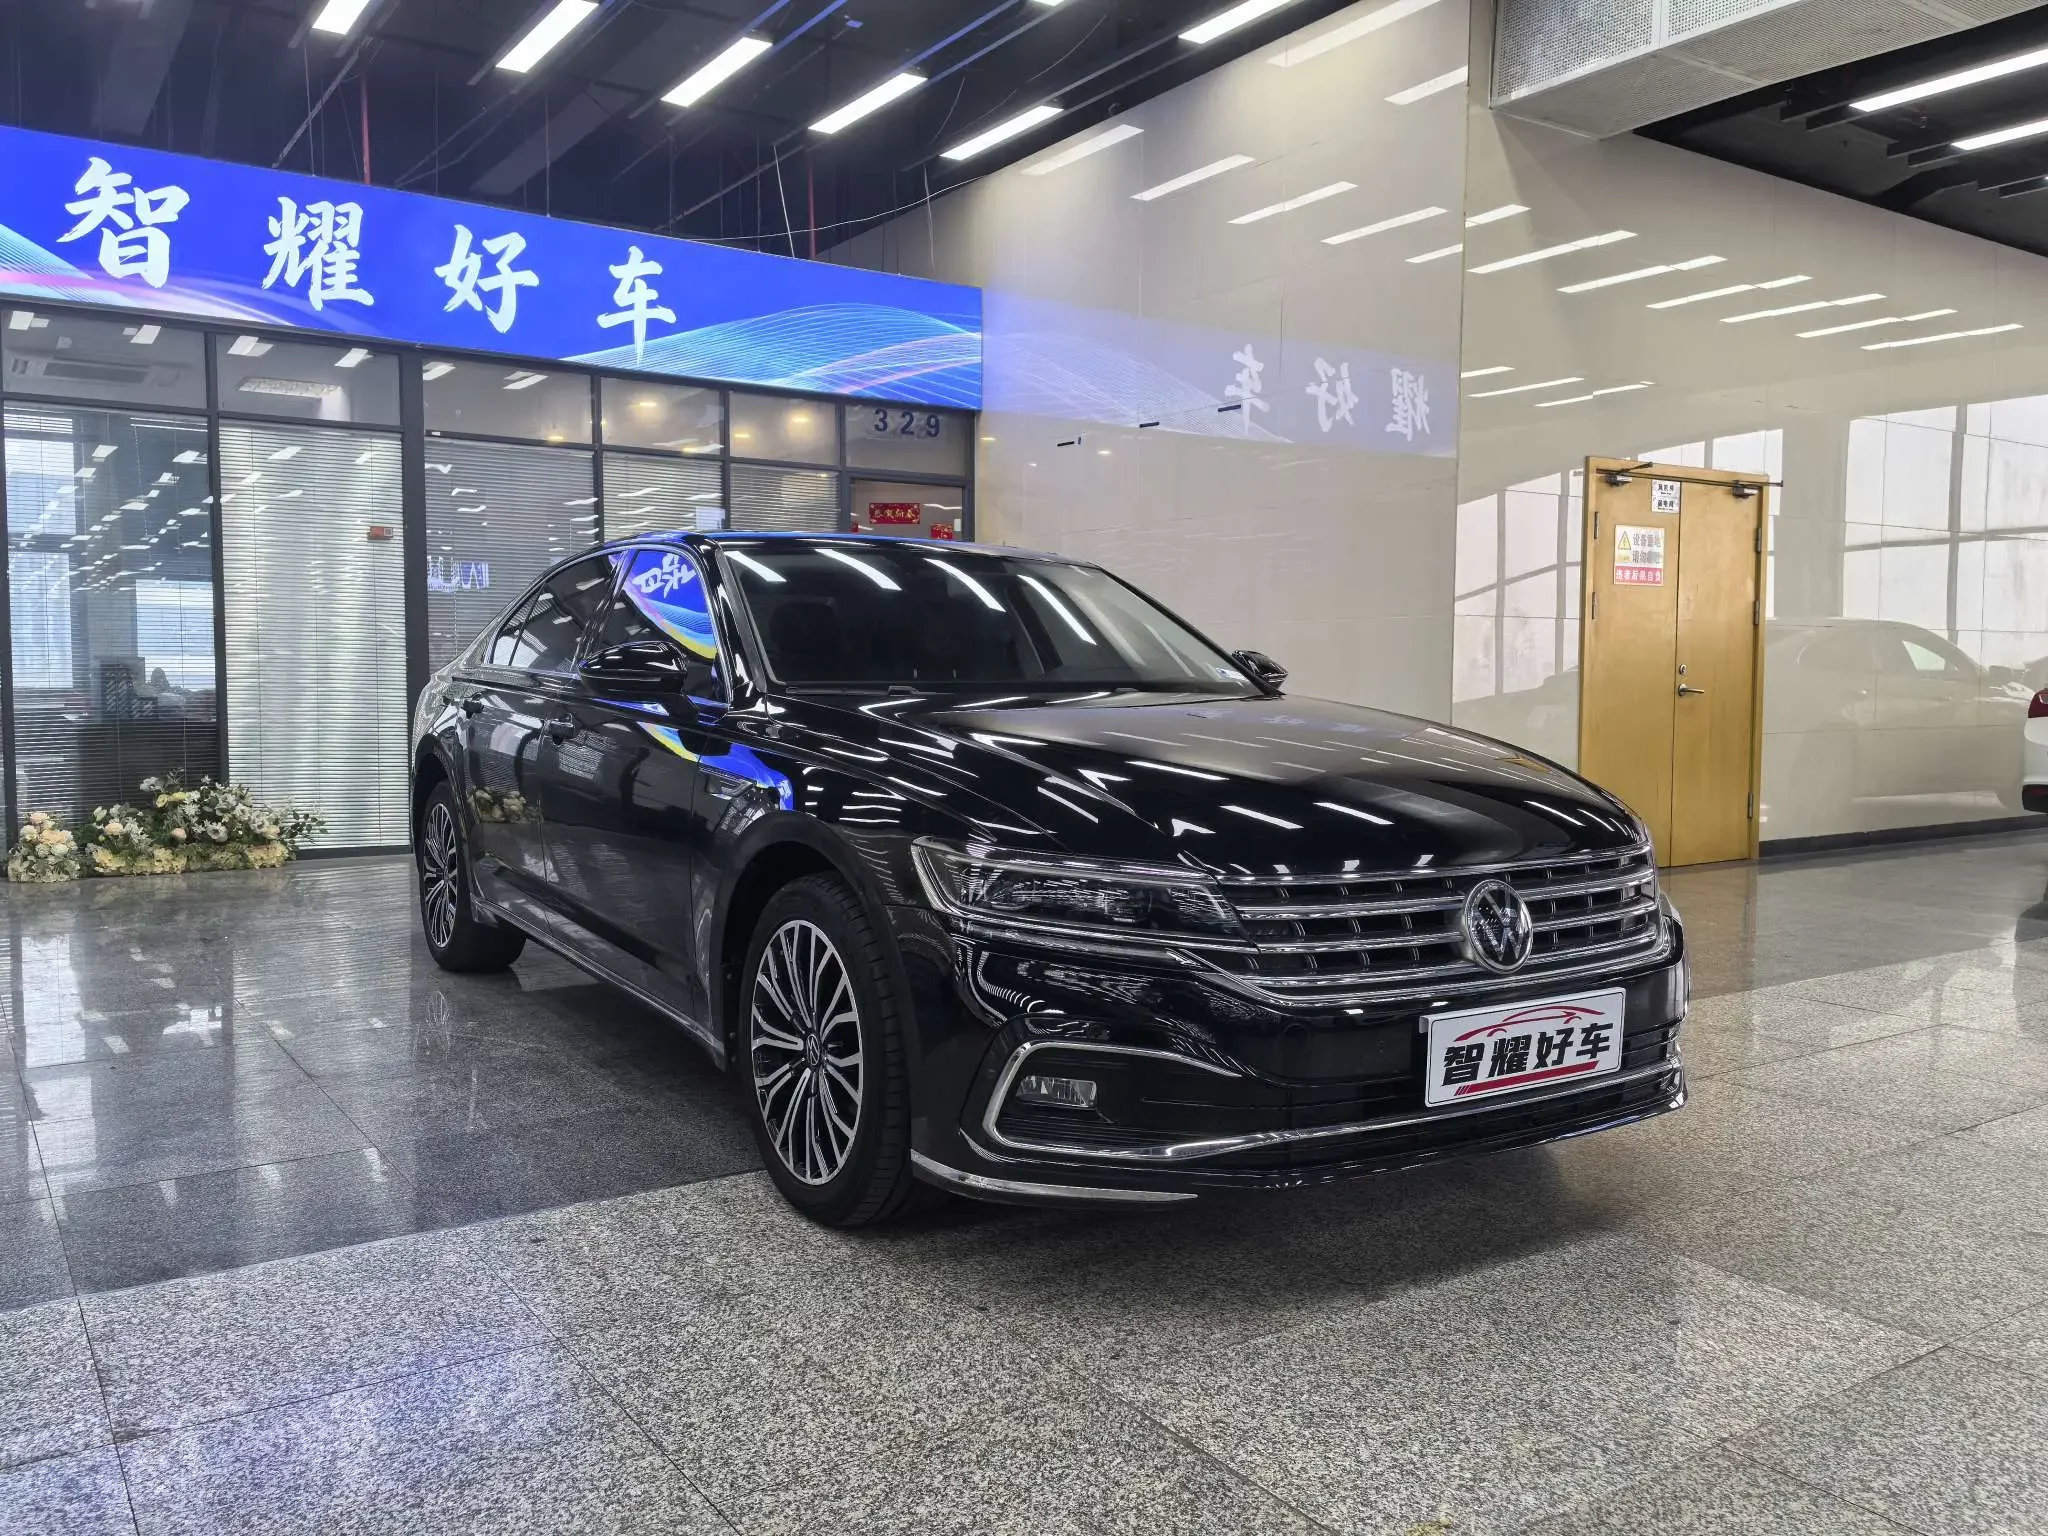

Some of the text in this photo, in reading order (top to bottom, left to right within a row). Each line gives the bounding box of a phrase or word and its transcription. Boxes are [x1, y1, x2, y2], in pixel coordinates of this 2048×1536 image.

[57, 157, 677, 367] 智耀好车
[874, 408, 940, 438] 329
[1441, 1022, 1614, 1087] 智耀好车
